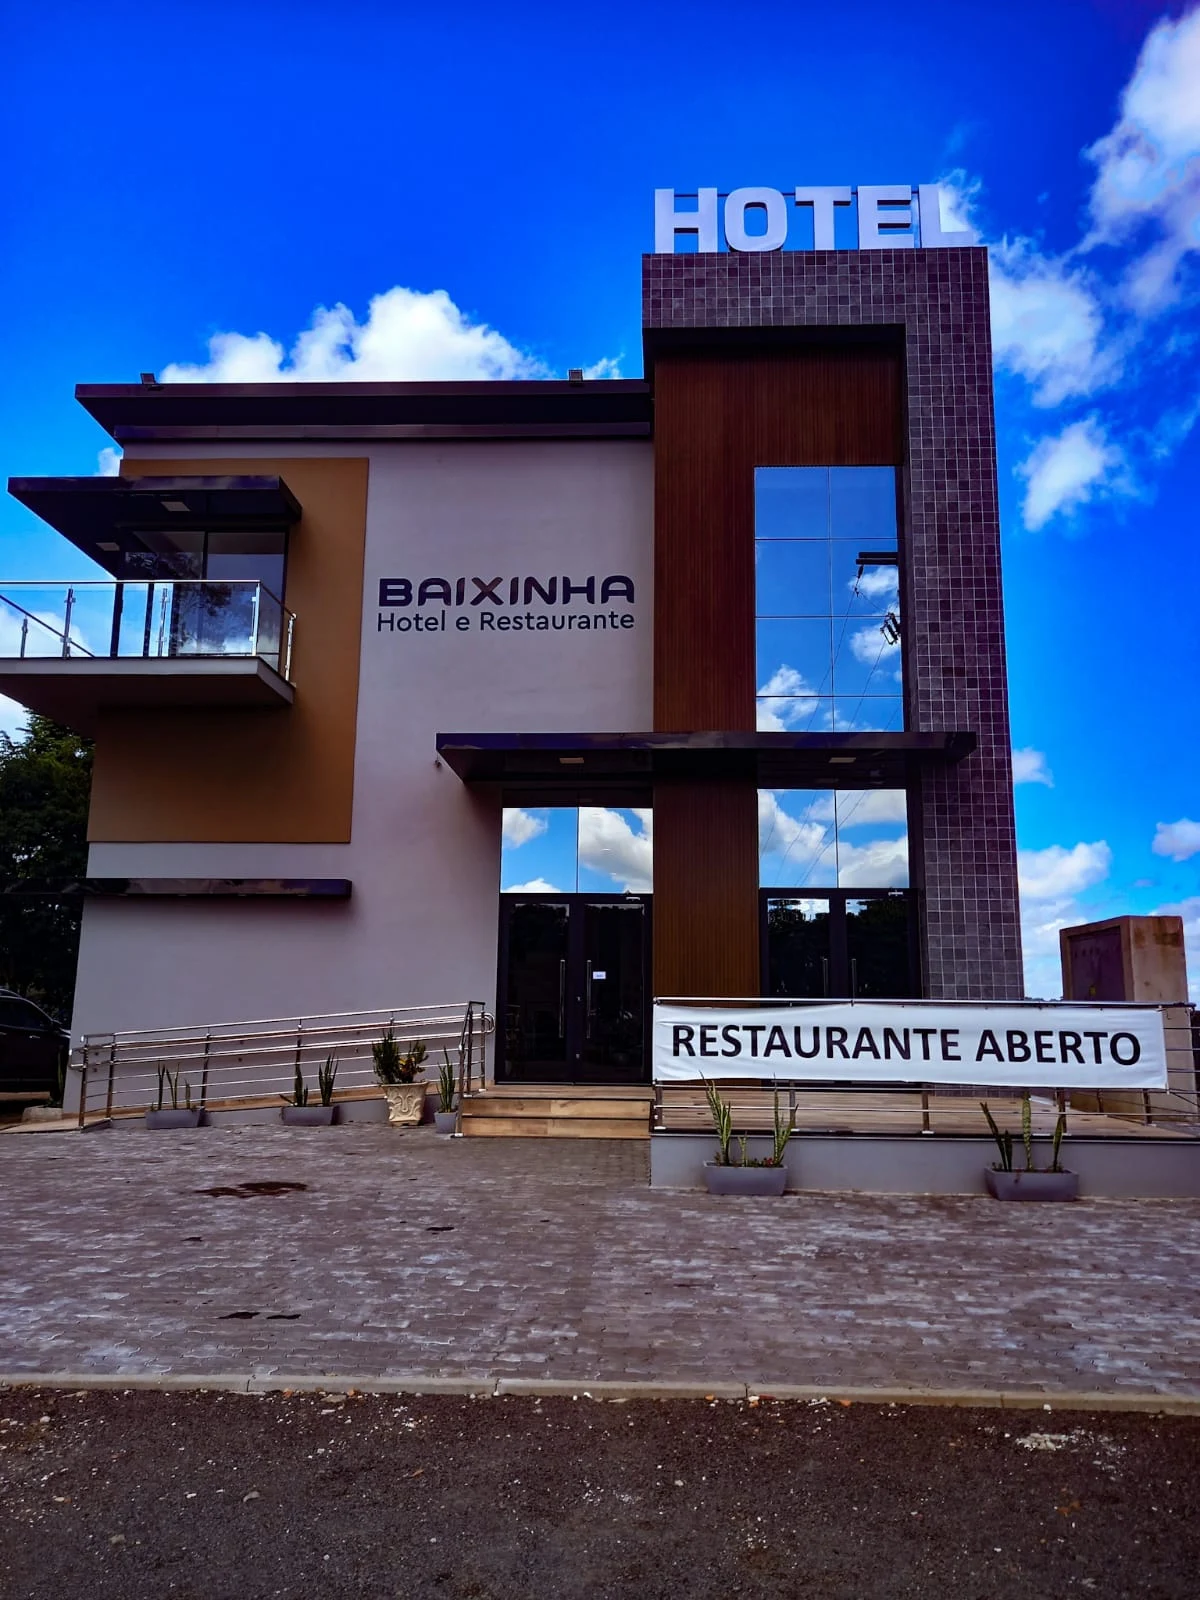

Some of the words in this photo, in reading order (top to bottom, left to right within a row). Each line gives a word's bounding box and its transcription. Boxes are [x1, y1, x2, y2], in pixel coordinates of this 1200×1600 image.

[654, 184, 975, 254] HOTEL
[378, 575, 635, 607] BAIXINHA
[377, 610, 446, 632] Hotel
[455, 616, 470, 632] e
[480, 611, 635, 632] Restaurante
[672, 1025, 961, 1061] RESTAURANTE
[975, 1029, 1141, 1066] ABERTO
